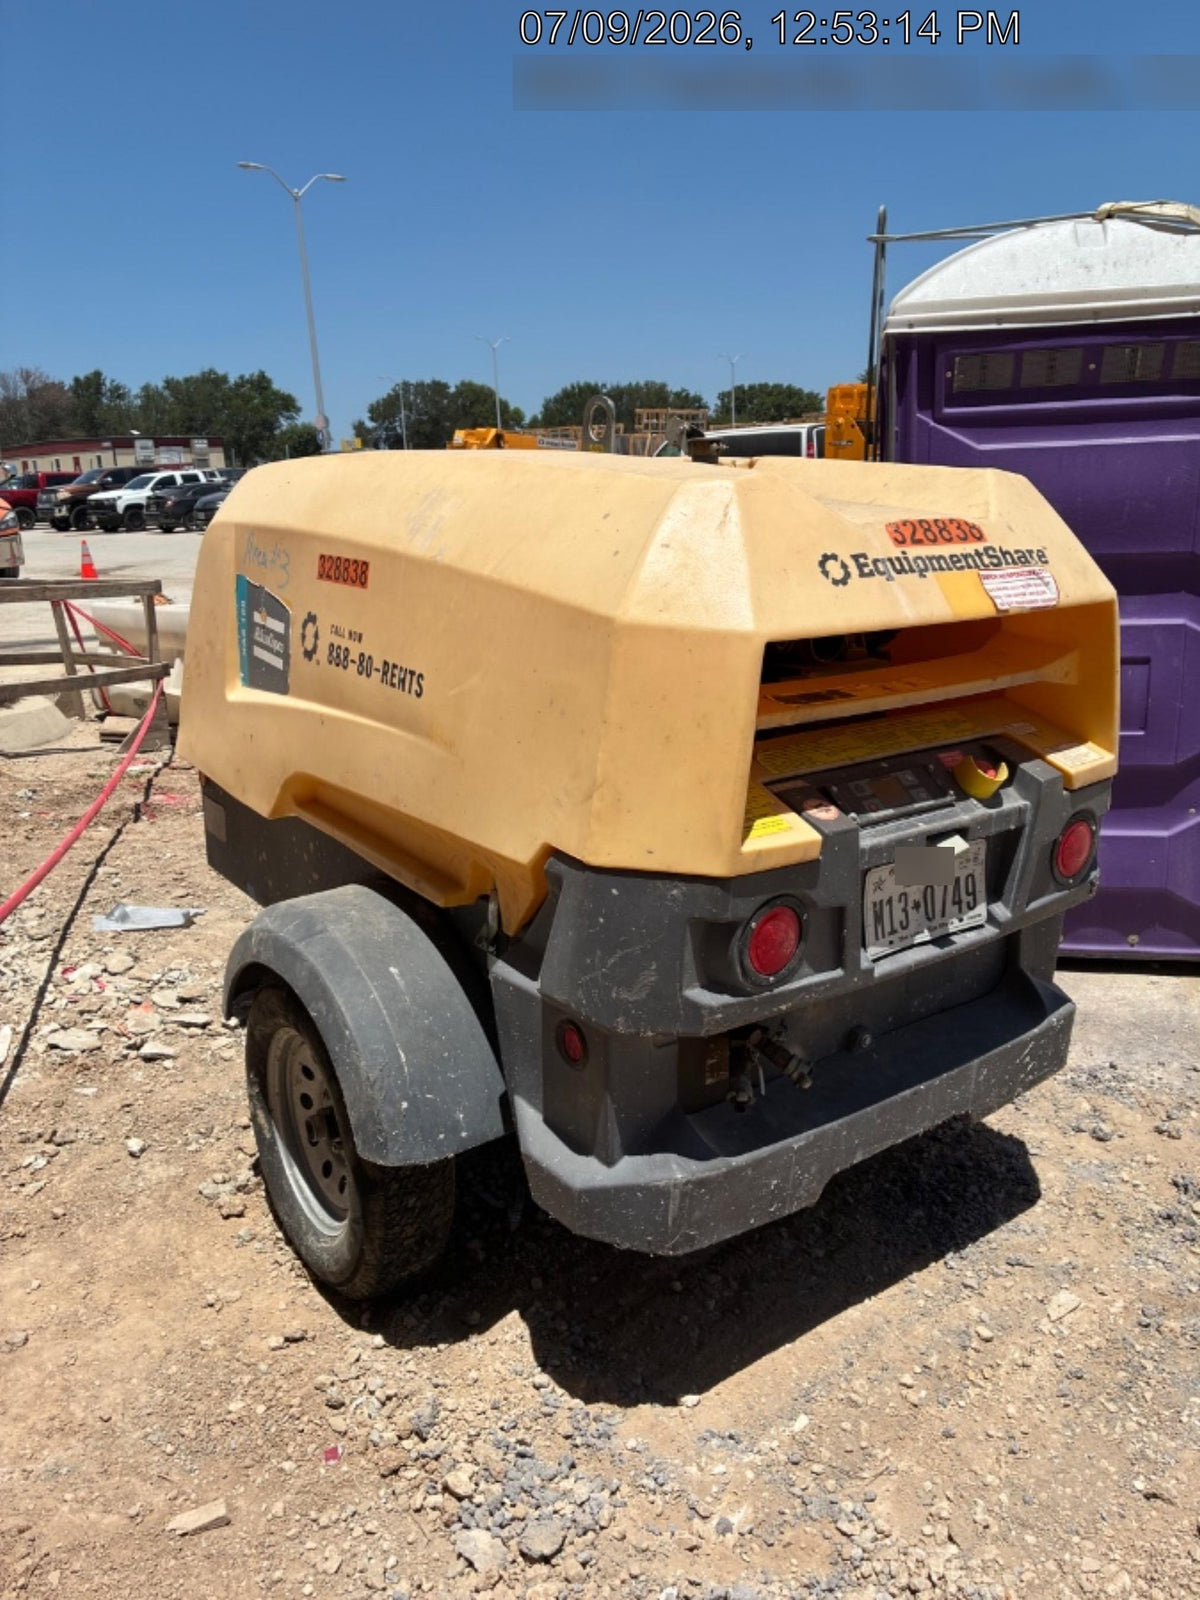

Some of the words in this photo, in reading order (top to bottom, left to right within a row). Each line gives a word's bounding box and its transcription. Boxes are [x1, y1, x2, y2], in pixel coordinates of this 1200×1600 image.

[317, 554, 369, 586] 328838
[851, 546, 1049, 581] EquipmentShare
[326, 641, 425, 699] 888-80-RENTS
